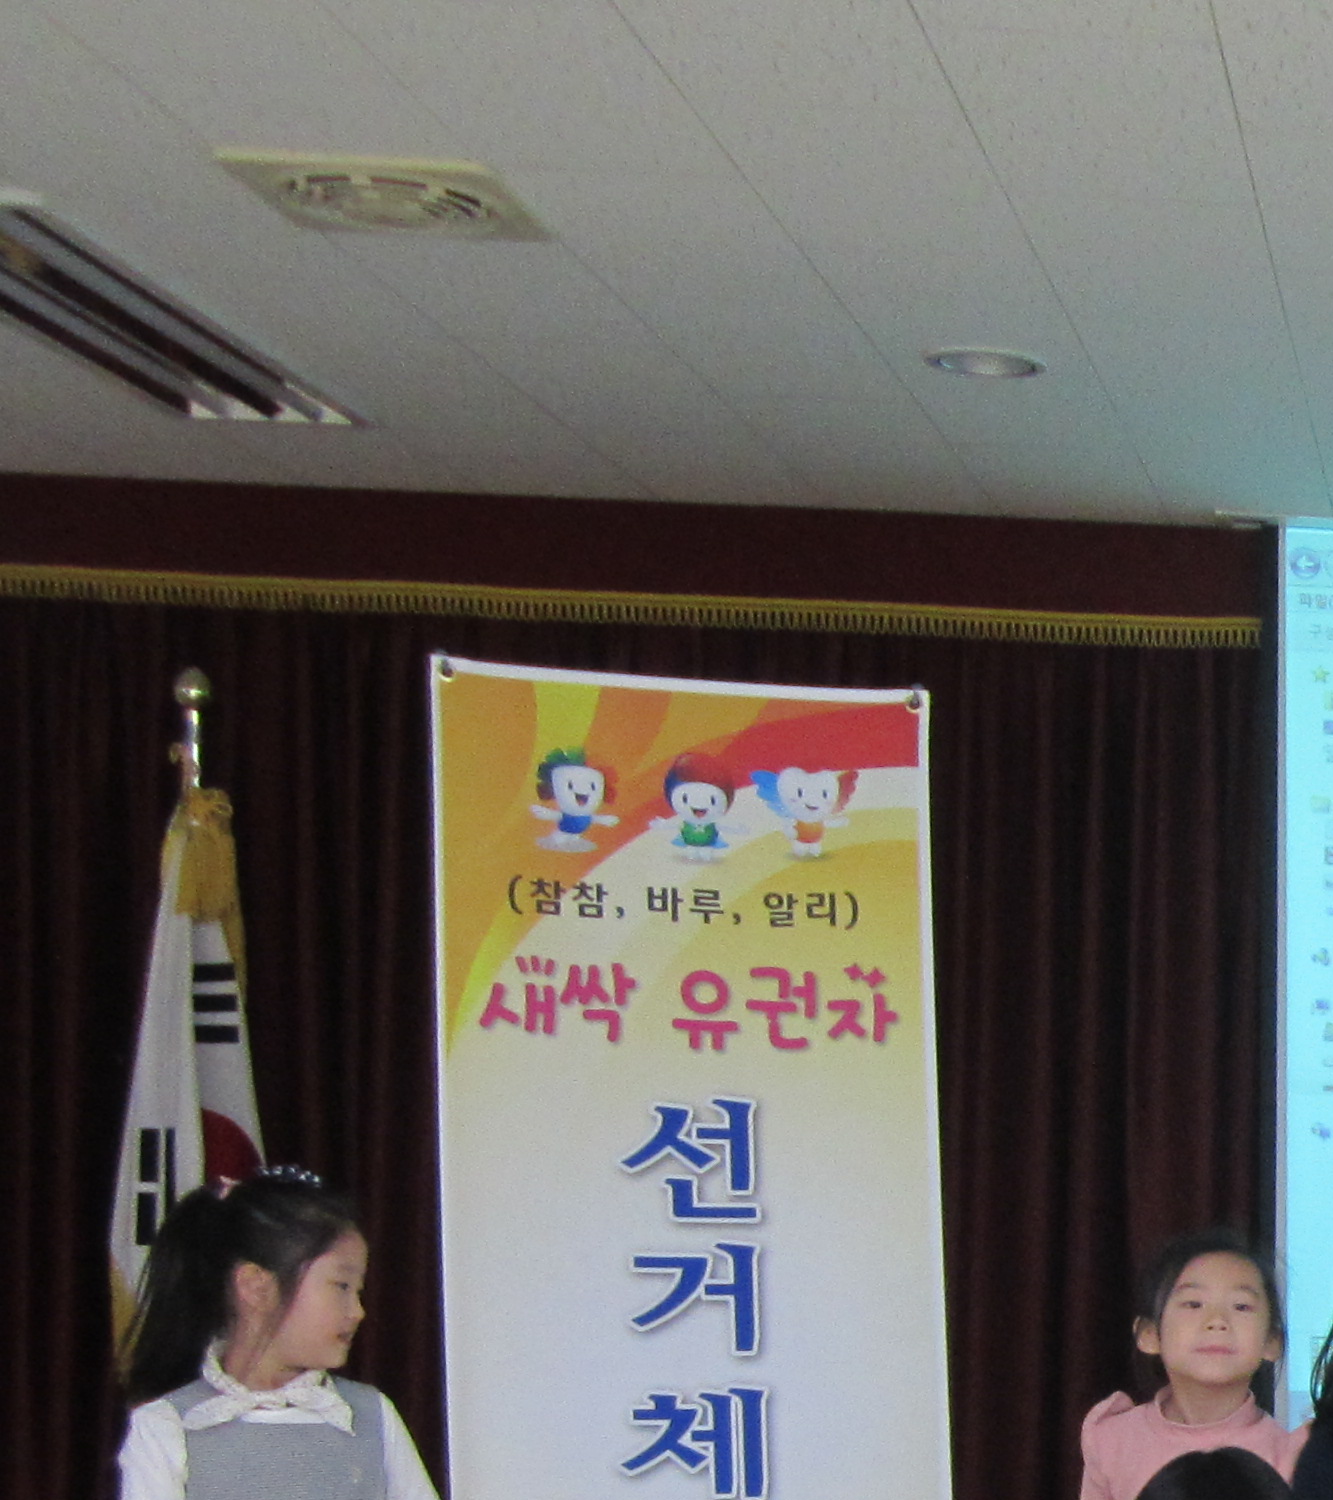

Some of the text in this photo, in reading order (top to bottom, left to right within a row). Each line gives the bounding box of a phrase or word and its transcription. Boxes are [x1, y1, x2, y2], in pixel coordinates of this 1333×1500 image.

[507, 874, 860, 930] (참참, 바루, 알리)
[480, 955, 900, 1052] 새싹 유권자
